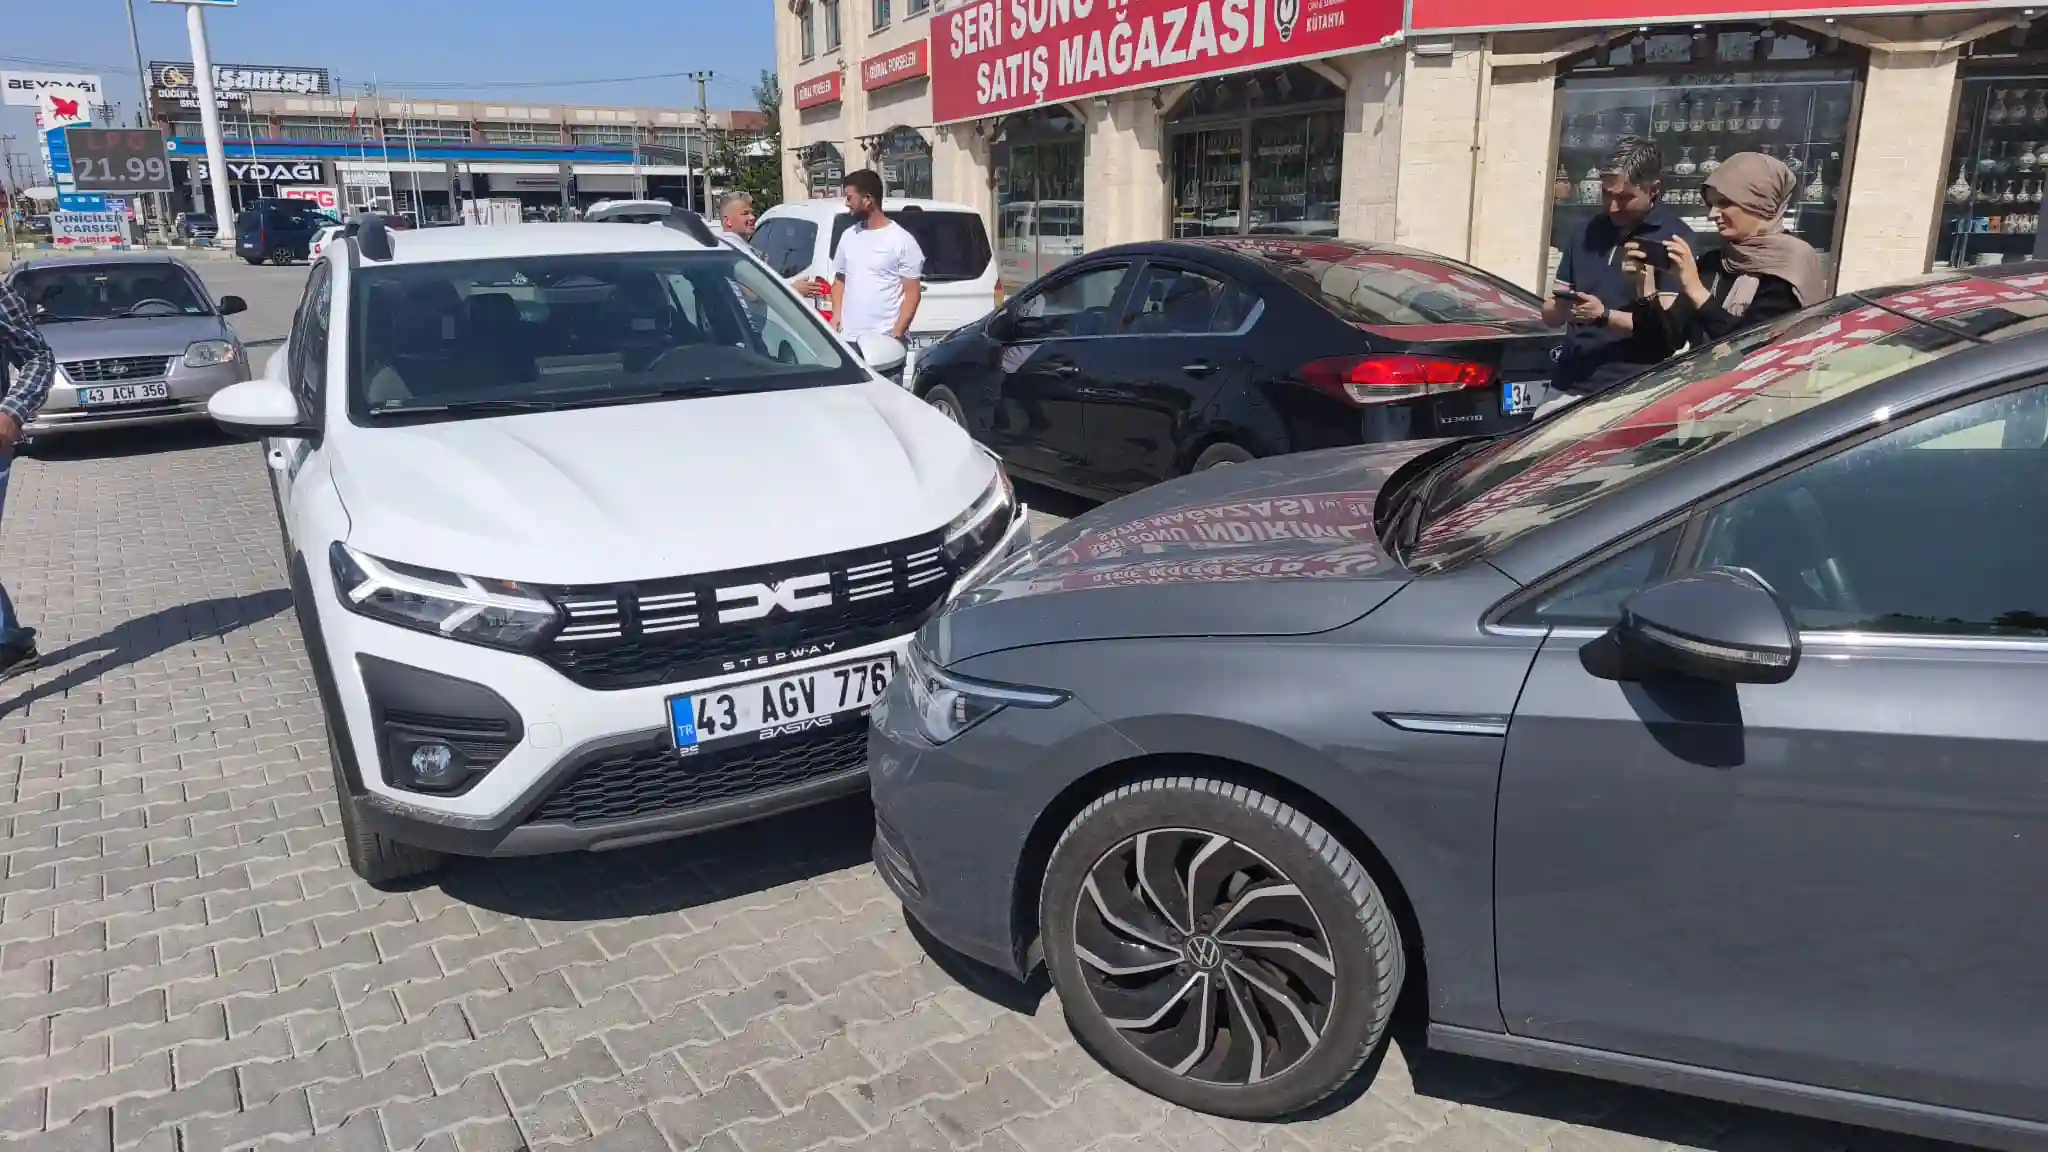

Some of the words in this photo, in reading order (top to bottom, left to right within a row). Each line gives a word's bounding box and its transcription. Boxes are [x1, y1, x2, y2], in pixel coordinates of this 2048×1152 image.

[950, 1, 1001, 59] SERİ
[1306, 10, 1345, 33] KÜTAHYA
[976, 45, 1049, 104] SATIŞ
[1058, 0, 1266, 87] MAĞAZASI
[193, 65, 320, 95] işantaşı
[75, 156, 165, 182] 21.99
[186, 160, 320, 181] BYDAĞI
[89, 389, 105, 402] 43
[112, 386, 136, 401] ACH
[142, 383, 165, 397] 356
[1512, 384, 1531, 406] 34
[722, 641, 837, 671] STEPWAY
[678, 724, 694, 737] TR
[697, 694, 738, 736] 43
[762, 676, 816, 724] AGV
[834, 662, 887, 707] 776
